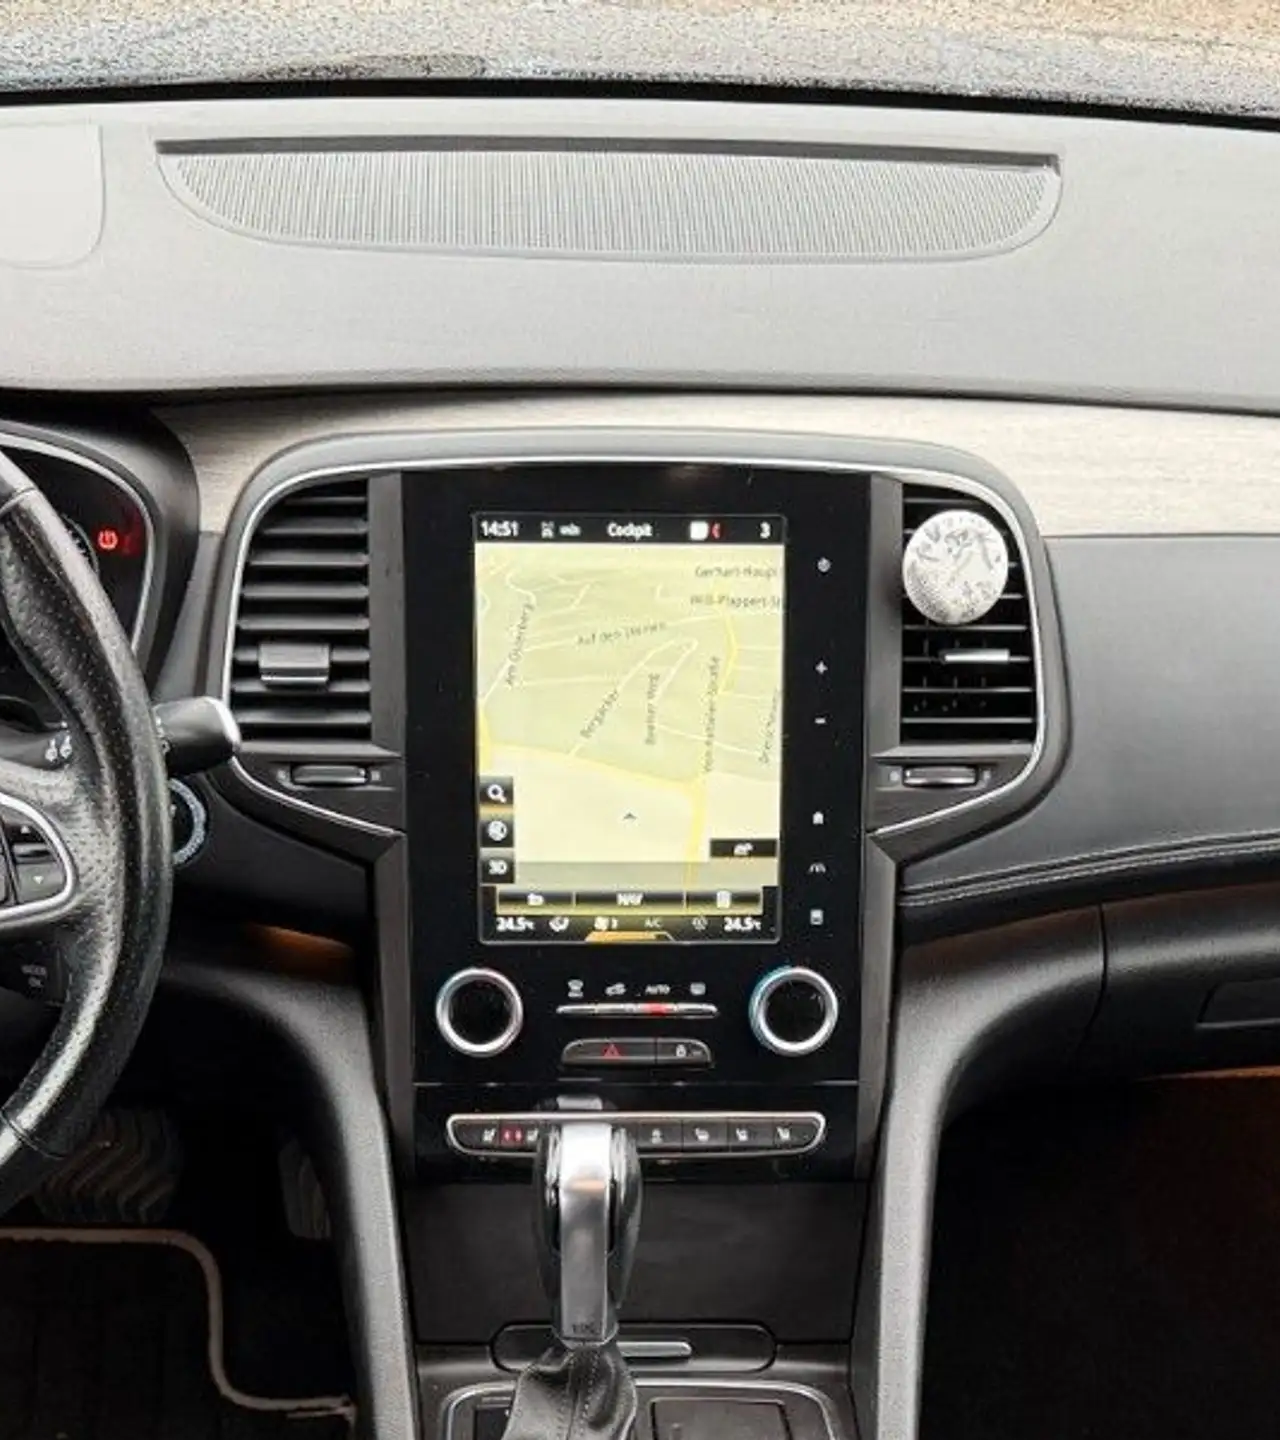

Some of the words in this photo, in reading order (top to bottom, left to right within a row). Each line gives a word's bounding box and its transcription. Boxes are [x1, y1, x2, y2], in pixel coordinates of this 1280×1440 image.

[481, 520, 519, 536] 14:51
[607, 522, 653, 541] Cockpit
[644, 984, 671, 996] AUTO
